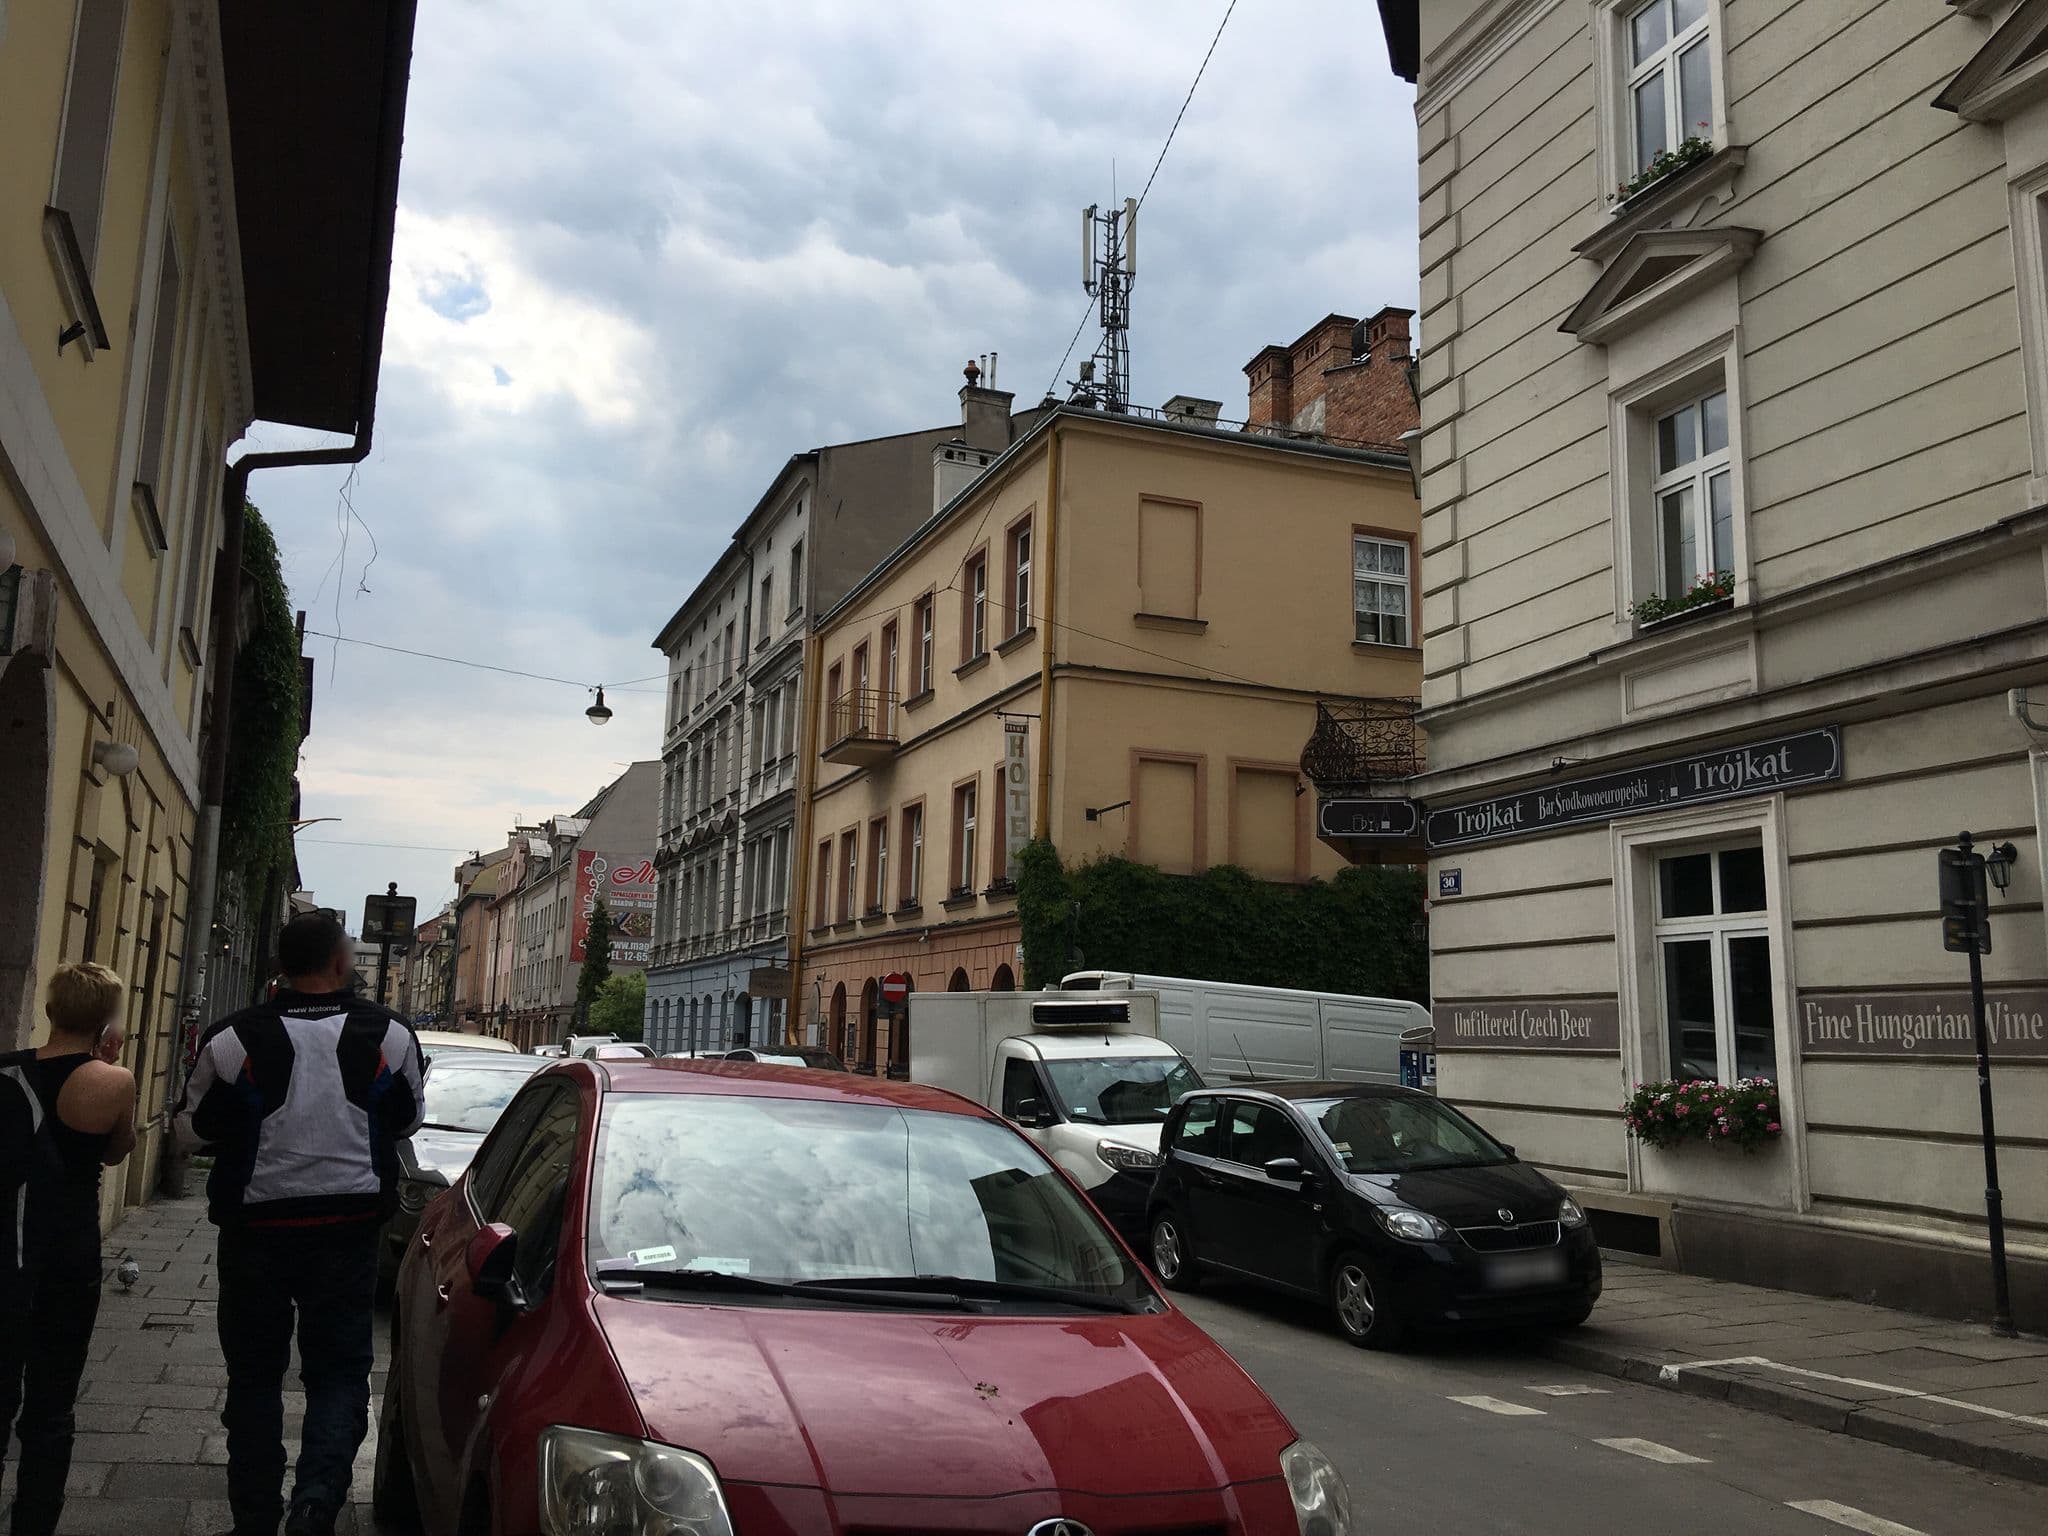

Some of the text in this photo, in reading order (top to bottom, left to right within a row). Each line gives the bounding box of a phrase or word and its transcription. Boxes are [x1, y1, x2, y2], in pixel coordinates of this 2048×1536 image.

[1008, 735, 1029, 855] HOTE
[1454, 745, 1793, 835] Trójkąt Bar Środkowoeuropejski Trójkąt
[1442, 876, 1455, 888] 30
[308, 1004, 341, 1013] Motorrad
[1454, 1008, 1592, 1041] Unfiltered Czech Beer
[1804, 1002, 1852, 1044] Fine
[1855, 1004, 1973, 1049] Hungarian
